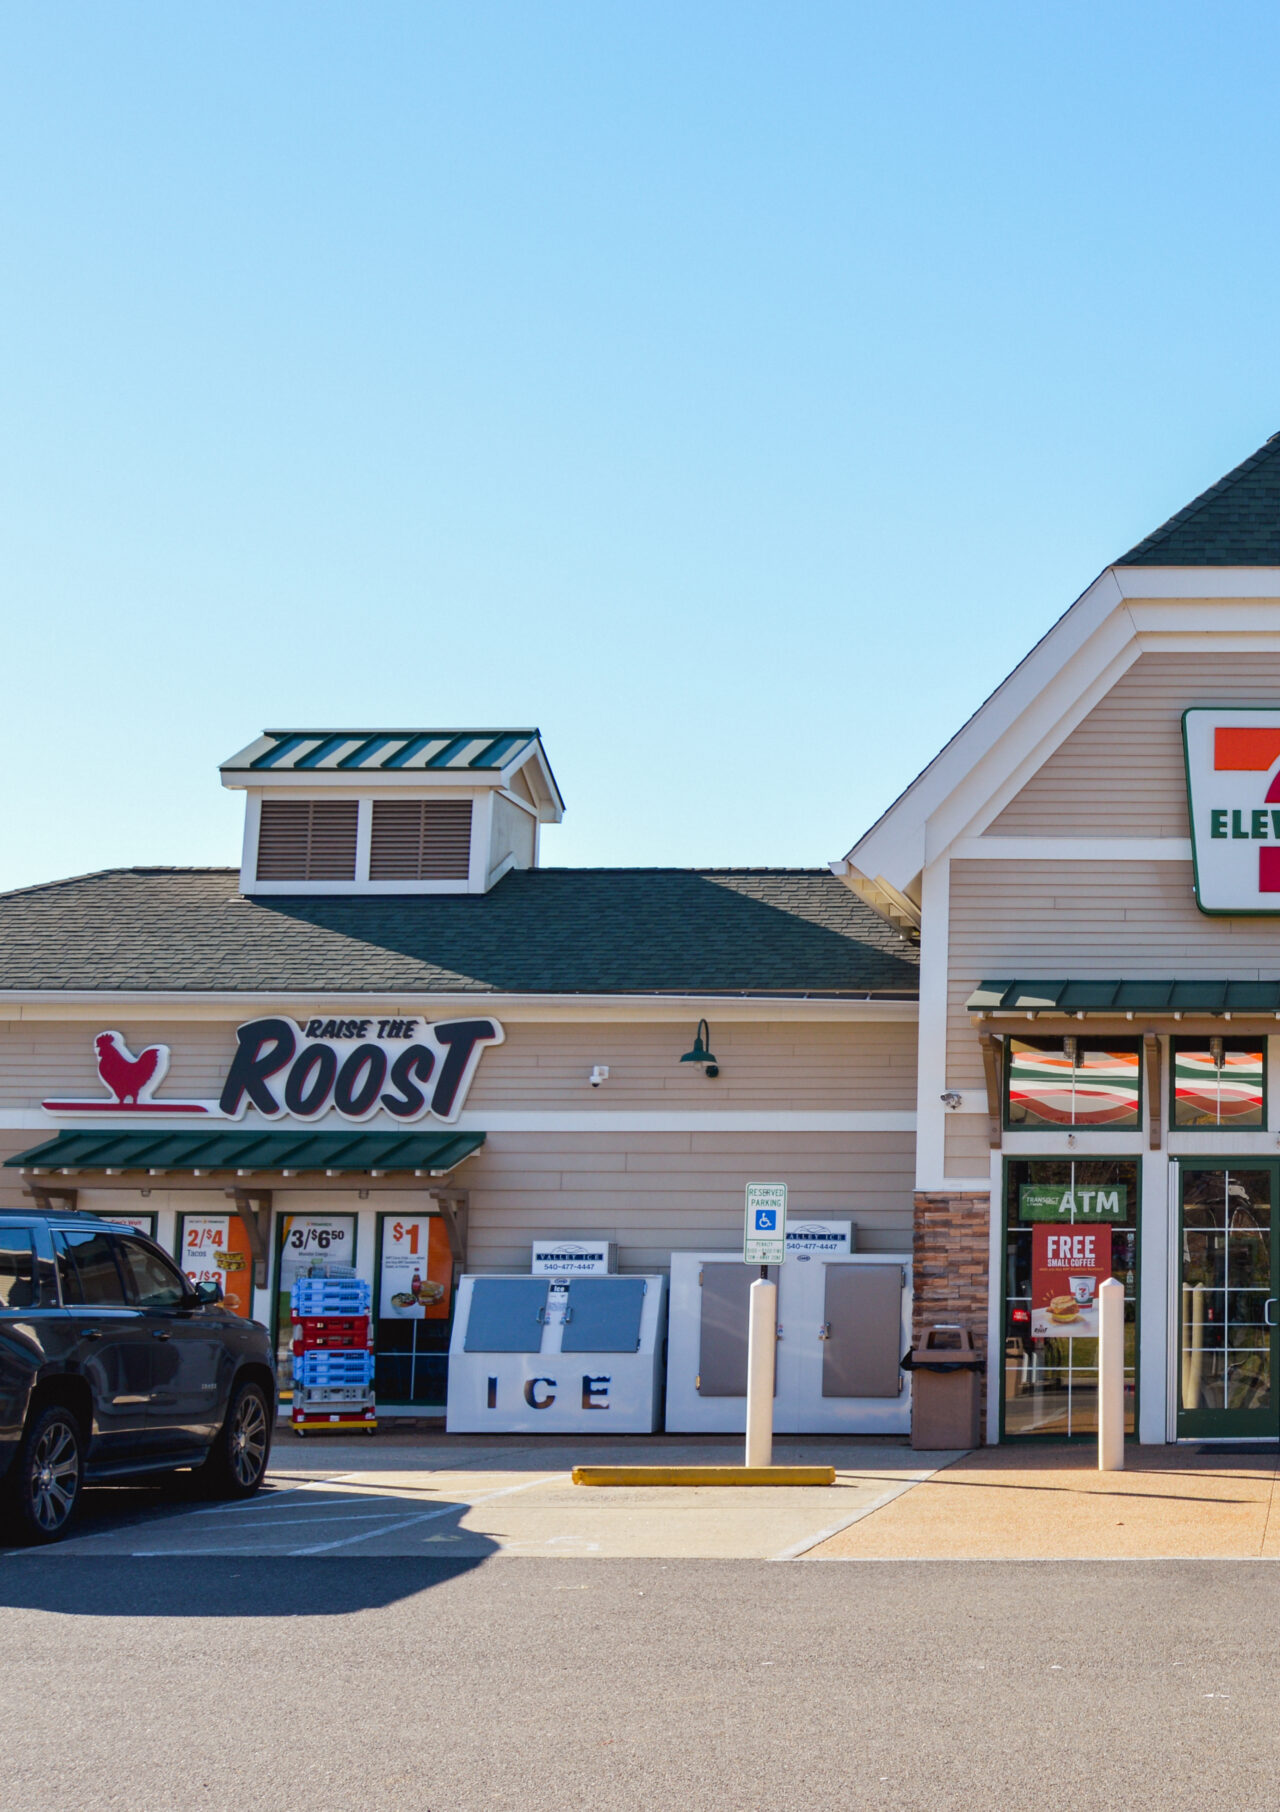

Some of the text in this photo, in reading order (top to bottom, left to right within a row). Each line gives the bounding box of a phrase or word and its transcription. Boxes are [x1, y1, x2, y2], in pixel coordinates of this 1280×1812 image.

[306, 1020, 419, 1039] RAISE THE
[219, 1018, 496, 1117] ROOST
[748, 1189, 784, 1197] RESERVED
[751, 1199, 782, 1207] PARKING
[1058, 1191, 1119, 1213] ATM
[187, 1228, 223, 1249] 2/$4
[393, 1222, 419, 1255] $1
[1047, 1236, 1096, 1258] FREE
[187, 1249, 206, 1257] Tacos
[1047, 1259, 1096, 1267] SMALL COFFEE
[487, 1375, 611, 1410] ICE
